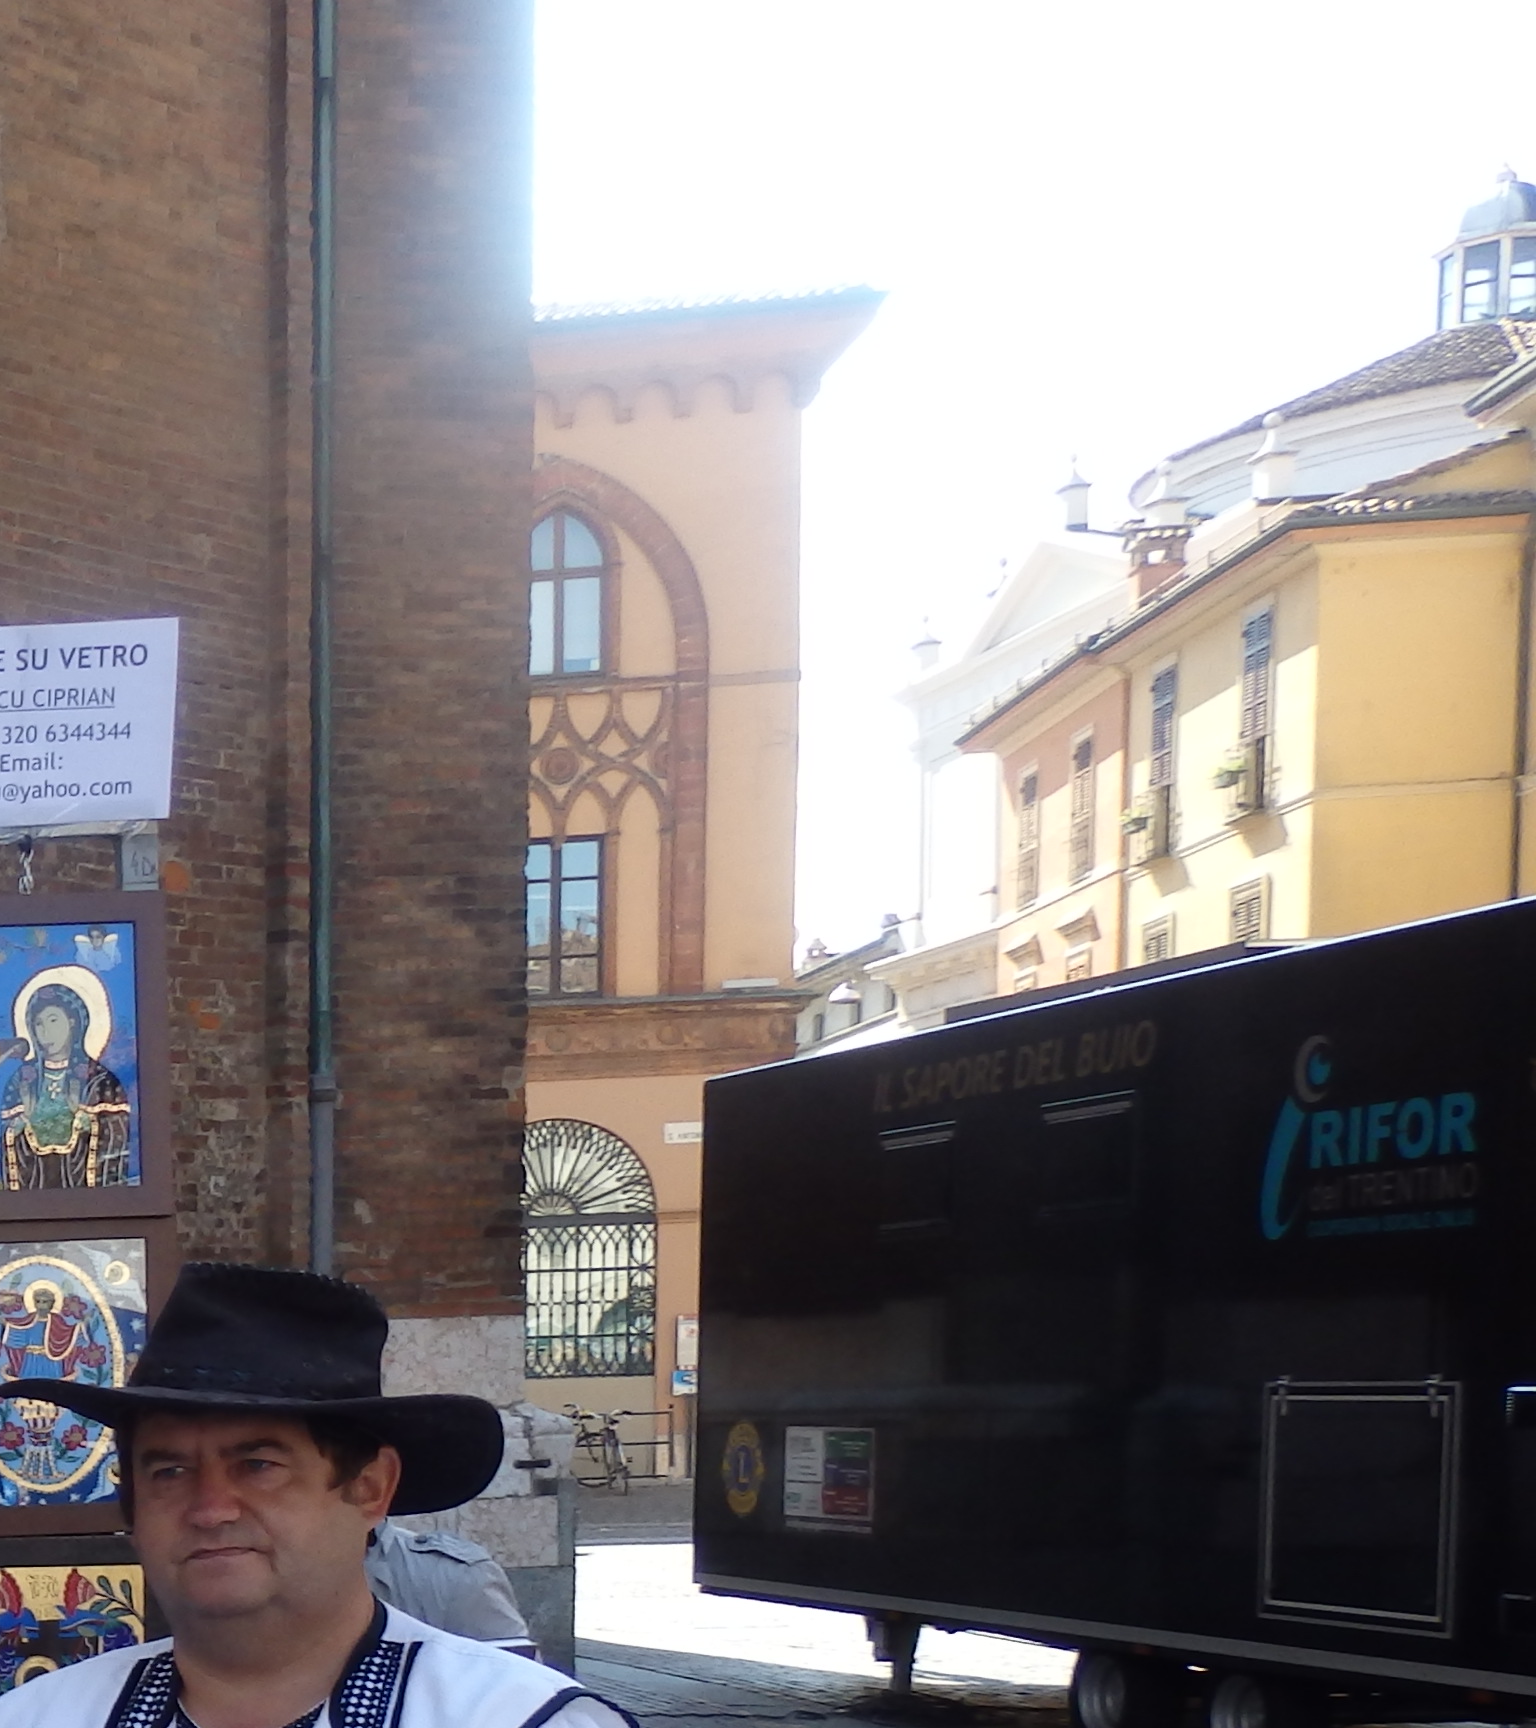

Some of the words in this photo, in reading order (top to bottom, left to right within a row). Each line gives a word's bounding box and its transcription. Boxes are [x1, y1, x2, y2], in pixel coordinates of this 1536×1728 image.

[15, 647, 49, 672] SU
[59, 643, 149, 669] VETRO
[32, 687, 116, 709] CIPRIAN
[1, 724, 38, 744] 320
[45, 721, 132, 742] 6344344
[0, 751, 64, 773] Email:
[899, 1048, 1008, 1110] SAPORE
[1013, 1038, 1066, 1090] DEL
[1307, 1091, 1477, 1170] RIFOR
